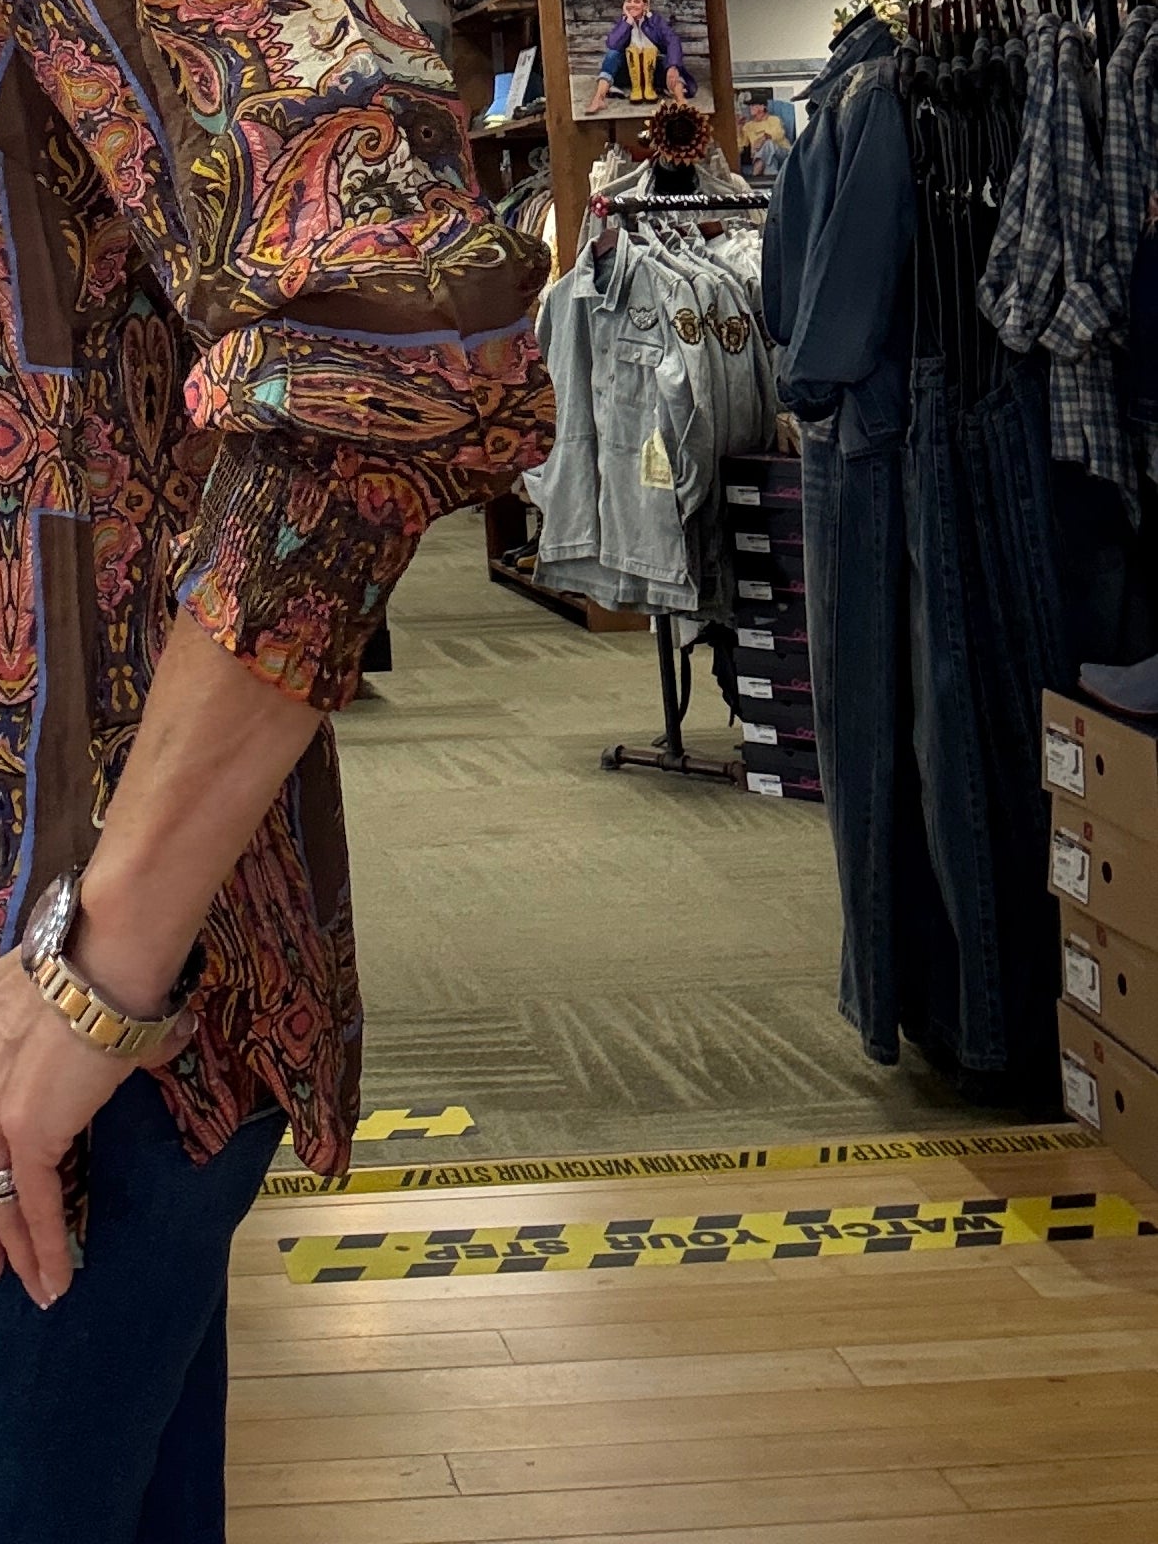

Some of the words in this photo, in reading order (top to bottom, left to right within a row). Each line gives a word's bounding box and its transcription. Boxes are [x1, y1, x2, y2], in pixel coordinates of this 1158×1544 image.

[851, 1143, 912, 1162] STEP
[914, 1139, 971, 1158] YOUR
[497, 1162, 560, 1182] YOUR
[558, 1156, 643, 1178] WATCH
[639, 1151, 738, 1174] CAUTION
[262, 1175, 316, 1195] CAUT
[435, 1166, 497, 1186] STEP
[800, 1215, 1005, 1241] WATCH
[604, 1229, 771, 1253] YOUR
